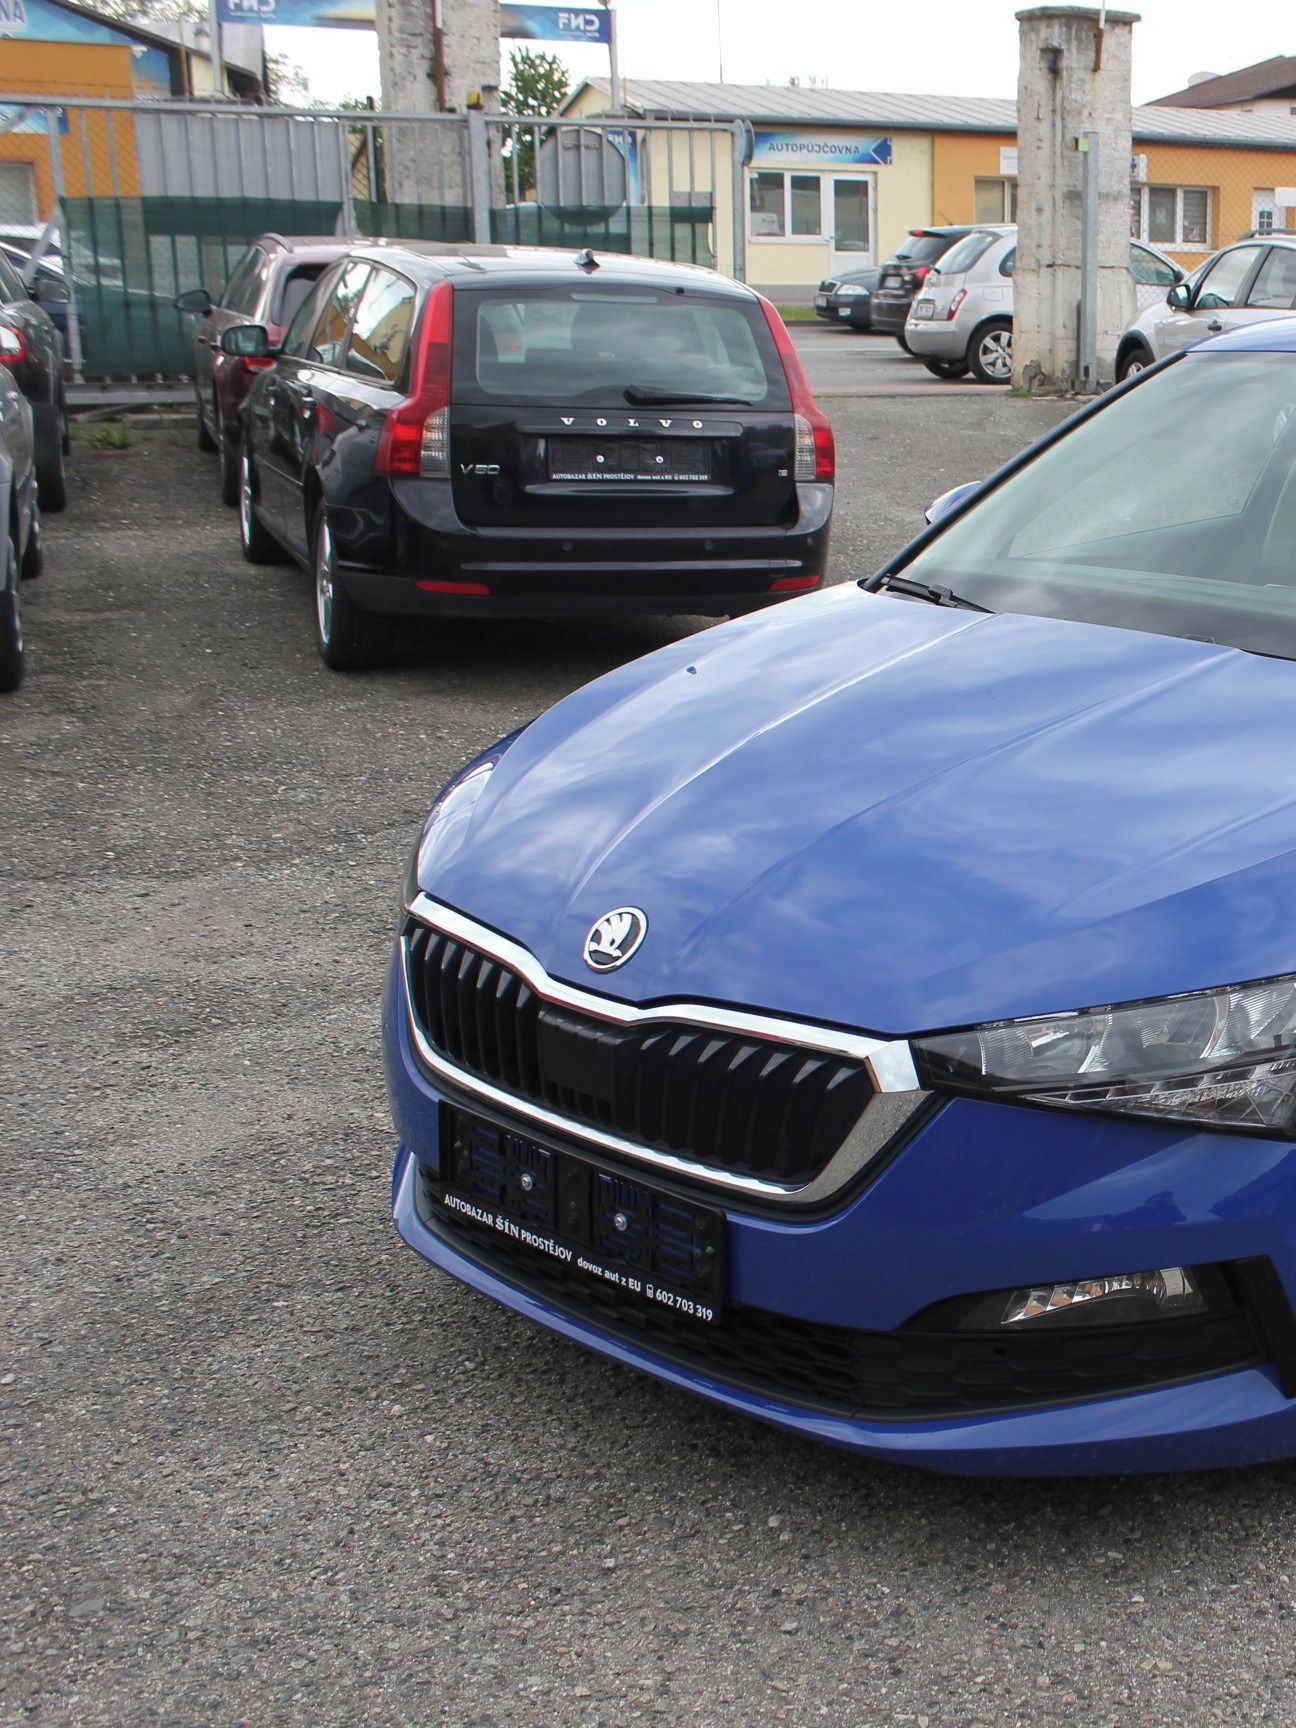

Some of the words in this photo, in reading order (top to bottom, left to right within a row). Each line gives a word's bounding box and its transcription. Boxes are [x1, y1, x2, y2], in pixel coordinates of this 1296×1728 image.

[768, 142, 860, 155] AUTOPŮJČOVNA
[560, 417, 703, 429] VOLVO
[460, 463, 500, 475] V50
[444, 1193, 494, 1227] AUTOBAZAR
[495, 1215, 519, 1239] ŠÍN
[521, 1229, 572, 1262] PROSTĚJOV
[577, 1257, 603, 1276] dovoz
[604, 1269, 620, 1284] aut
[621, 1276, 627, 1286] z
[628, 1277, 641, 1292] EU
[656, 1289, 674, 1306] 602
[676, 1296, 694, 1314] 703
[696, 1304, 713, 1321] 319
